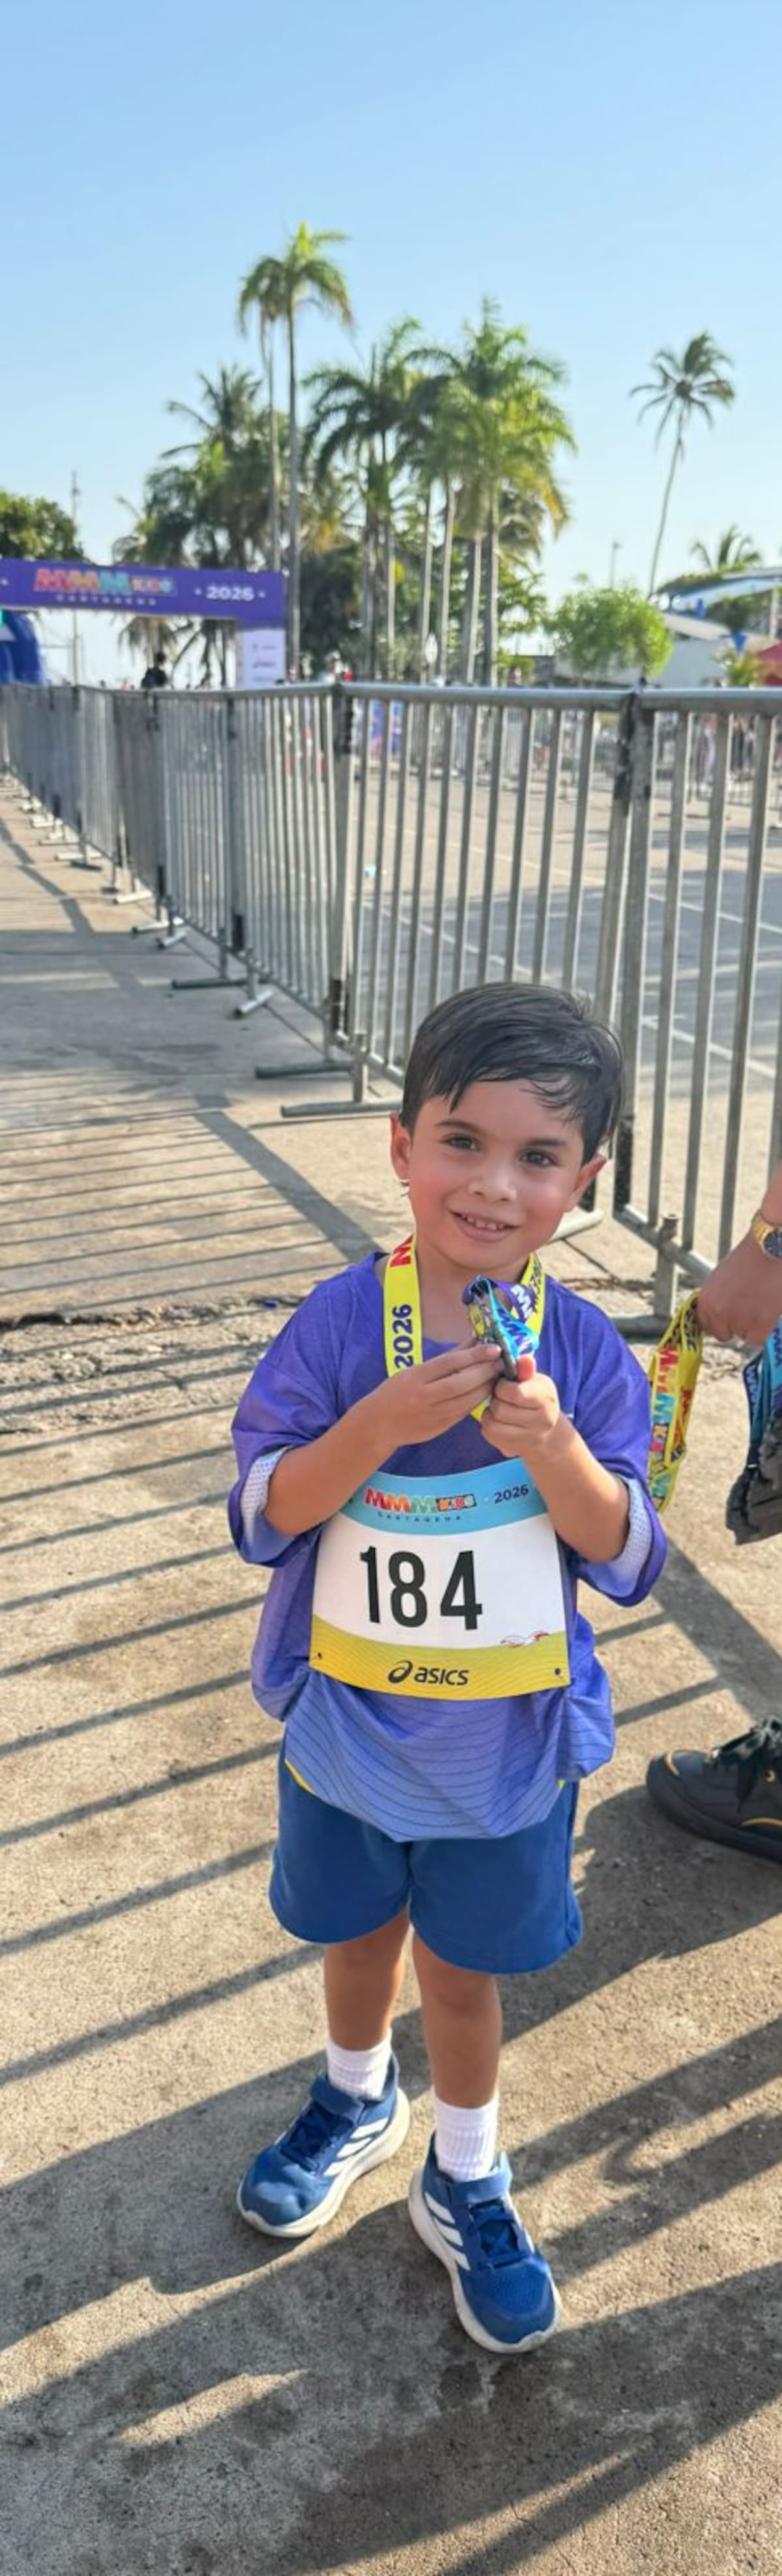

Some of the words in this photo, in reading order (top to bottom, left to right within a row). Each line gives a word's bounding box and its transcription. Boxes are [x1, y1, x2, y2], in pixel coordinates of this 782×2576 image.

[206, 585, 255, 601] 2026
[392, 1304, 414, 1369] 2026
[494, 1484, 530, 1503] 2026
[360, 1545, 483, 1631] 184
